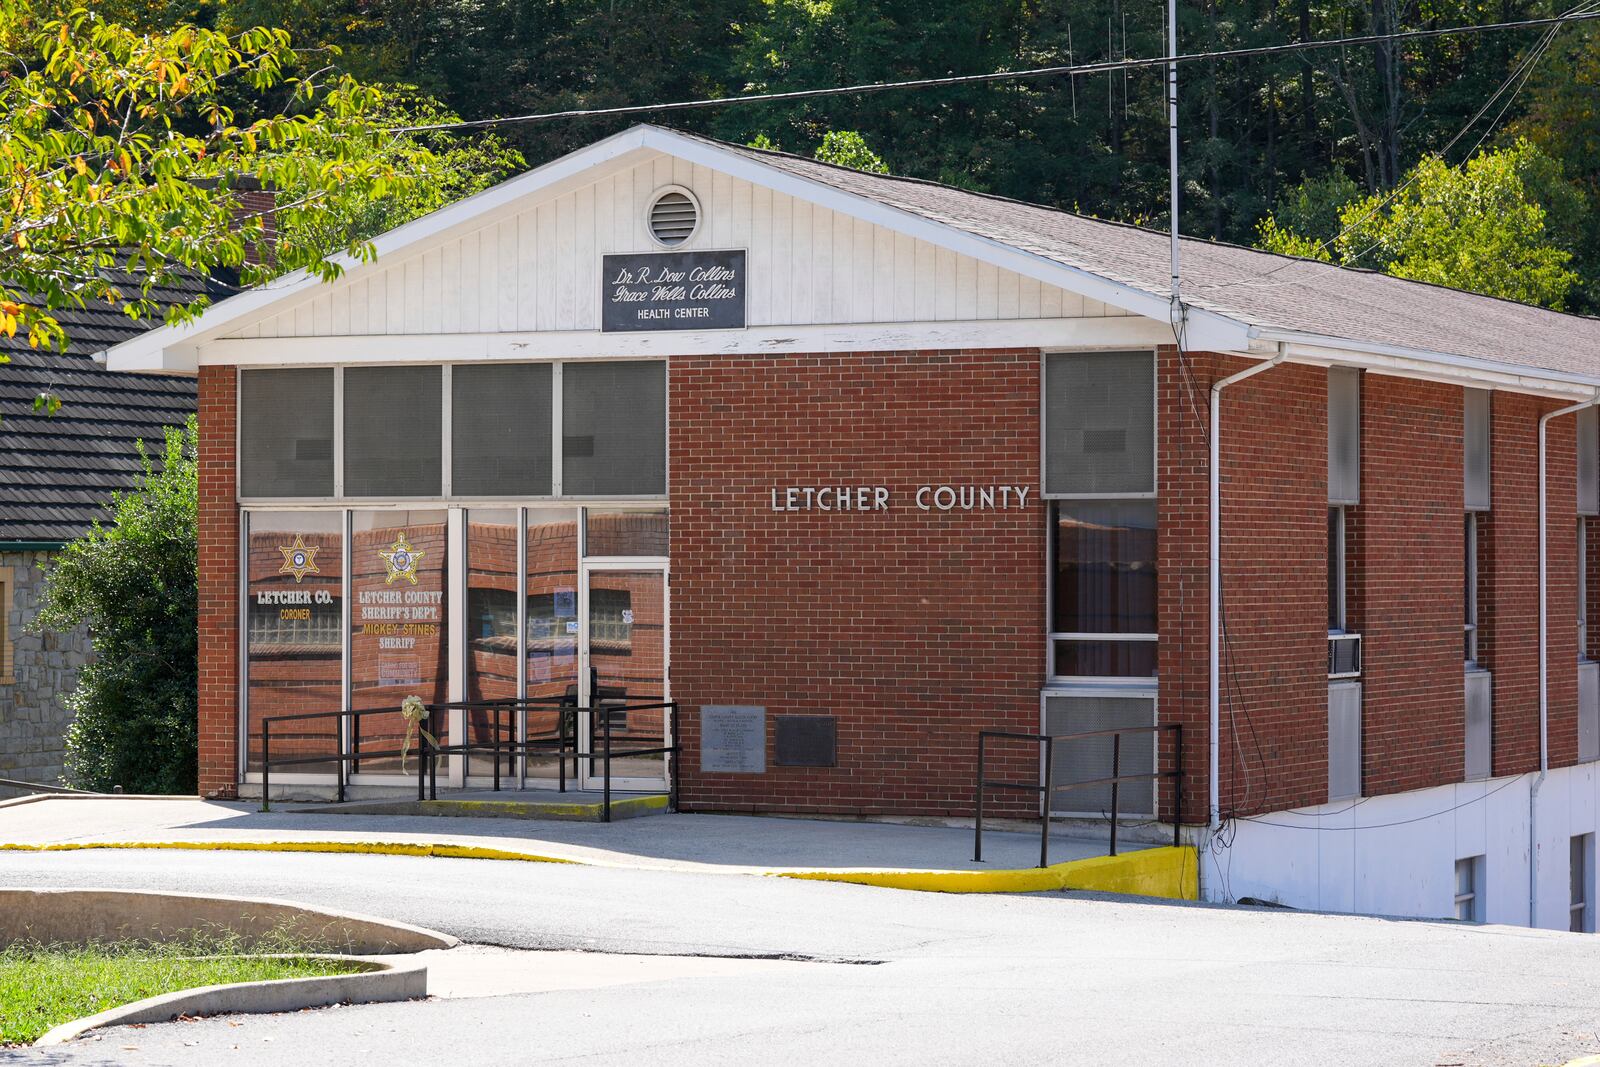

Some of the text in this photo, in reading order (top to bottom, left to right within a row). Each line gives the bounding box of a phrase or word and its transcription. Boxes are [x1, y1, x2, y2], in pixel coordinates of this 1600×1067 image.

[612, 267, 633, 284] Dr.
[653, 267, 685, 283] Dow
[689, 266, 735, 282] Collins
[612, 284, 736, 302] Grace Wells Collins
[638, 307, 709, 319] HEALTH CENTER
[771, 486, 1029, 512] LETCHER COUNTY
[257, 590, 333, 604] LETCHER CO.
[359, 591, 443, 604] LETCHER COUNTY
[280, 609, 311, 620] CORONER
[361, 606, 438, 620] SHERIFF'S DEPT.
[363, 623, 436, 635] MICKEY STINES
[379, 637, 415, 649] SHERIFF
